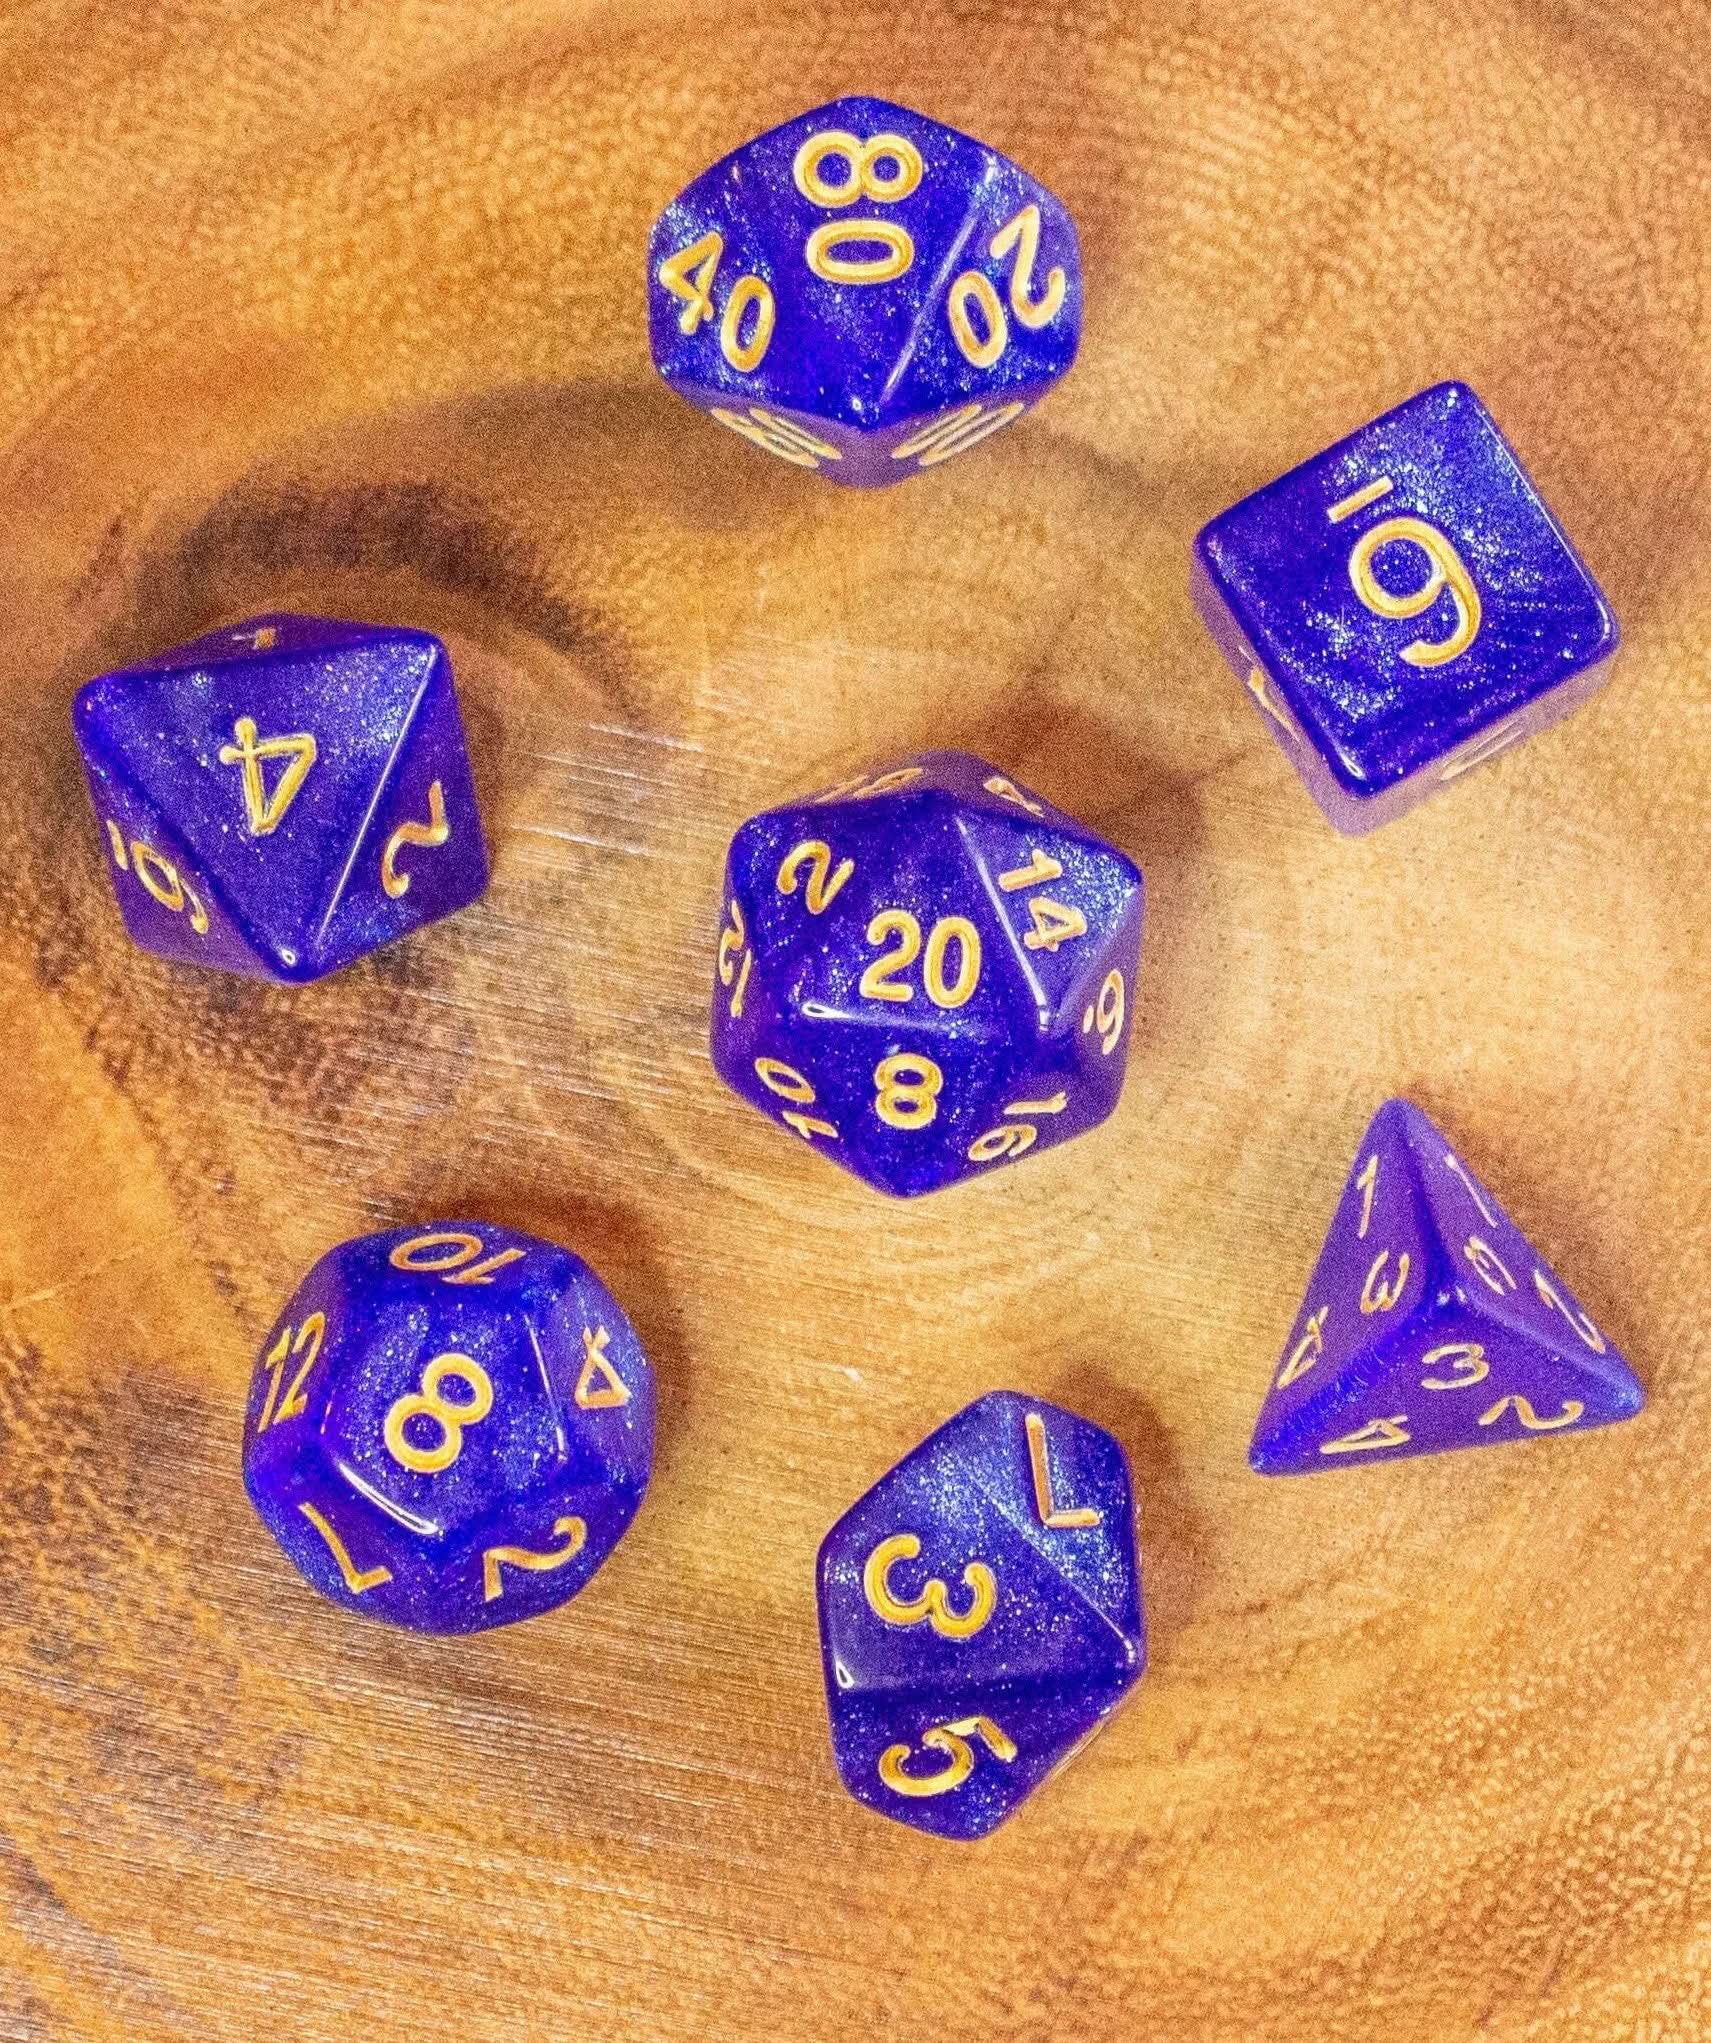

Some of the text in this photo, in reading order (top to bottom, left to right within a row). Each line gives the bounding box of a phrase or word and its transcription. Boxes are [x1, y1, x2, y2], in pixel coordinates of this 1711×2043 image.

[793, 130, 923, 285] 80
[658, 229, 775, 373] 40
[948, 204, 1065, 368] 20
[220, 717, 316, 836] 4
[777, 840, 855, 915] 2
[999, 849, 1088, 951] 14
[860, 909, 981, 1008] 20
[755, 1057, 839, 1138] 10
[874, 1053, 943, 1130] 8
[967, 1090, 1068, 1161] 16
[1357, 1154, 1378, 1239] 1
[389, 1232, 526, 1285] 10
[1360, 1251, 1409, 1313] 3
[258, 1311, 326, 1432] 12
[575, 1326, 632, 1409] 4
[1421, 1344, 1490, 1390] 3
[384, 1353, 494, 1474] 8
[1478, 1395, 1583, 1430] 2
[483, 1515, 587, 1602] 2
[864, 1534, 998, 1640] 3
[878, 1716, 1018, 1797] 5
